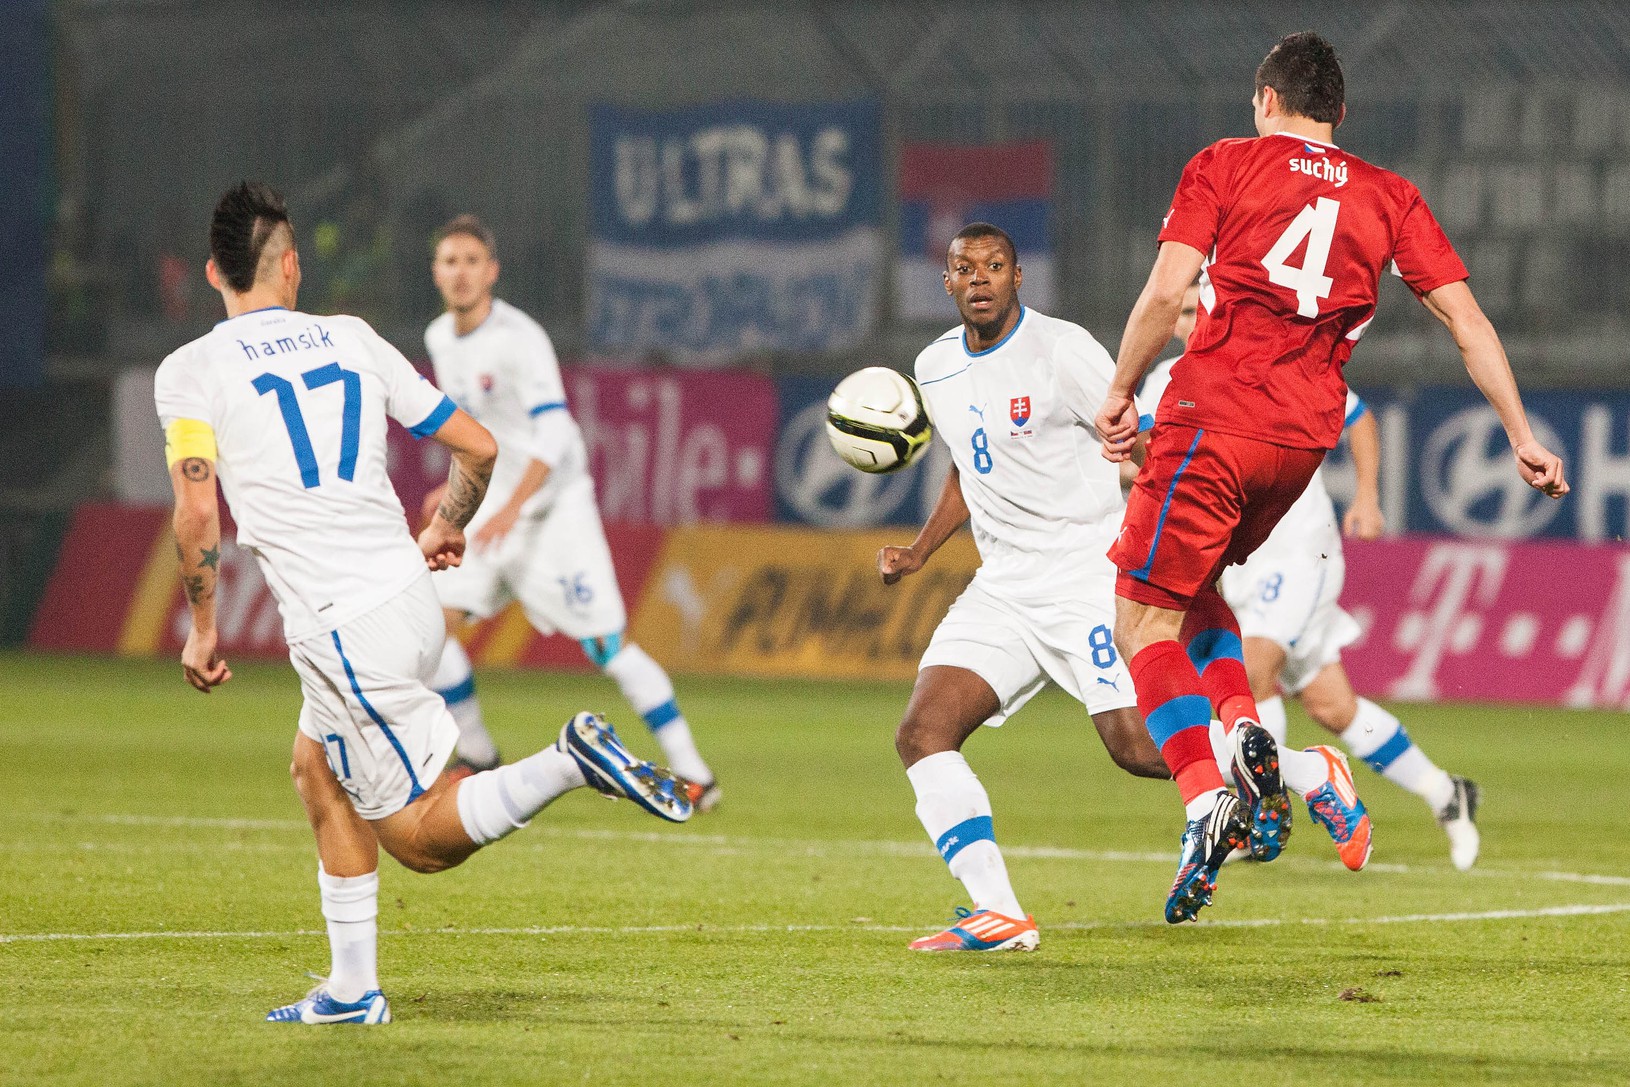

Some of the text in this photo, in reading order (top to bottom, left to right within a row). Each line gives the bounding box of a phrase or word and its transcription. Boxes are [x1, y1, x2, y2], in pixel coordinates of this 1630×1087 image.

[613, 125, 852, 226] ULTRAS
[1289, 157, 1349, 188] suchý
[1260, 196, 1341, 319] 4
[235, 323, 335, 361] hamsik
[251, 361, 362, 489] 17
[970, 427, 993, 475] 8
[1087, 623, 1118, 670] 8
